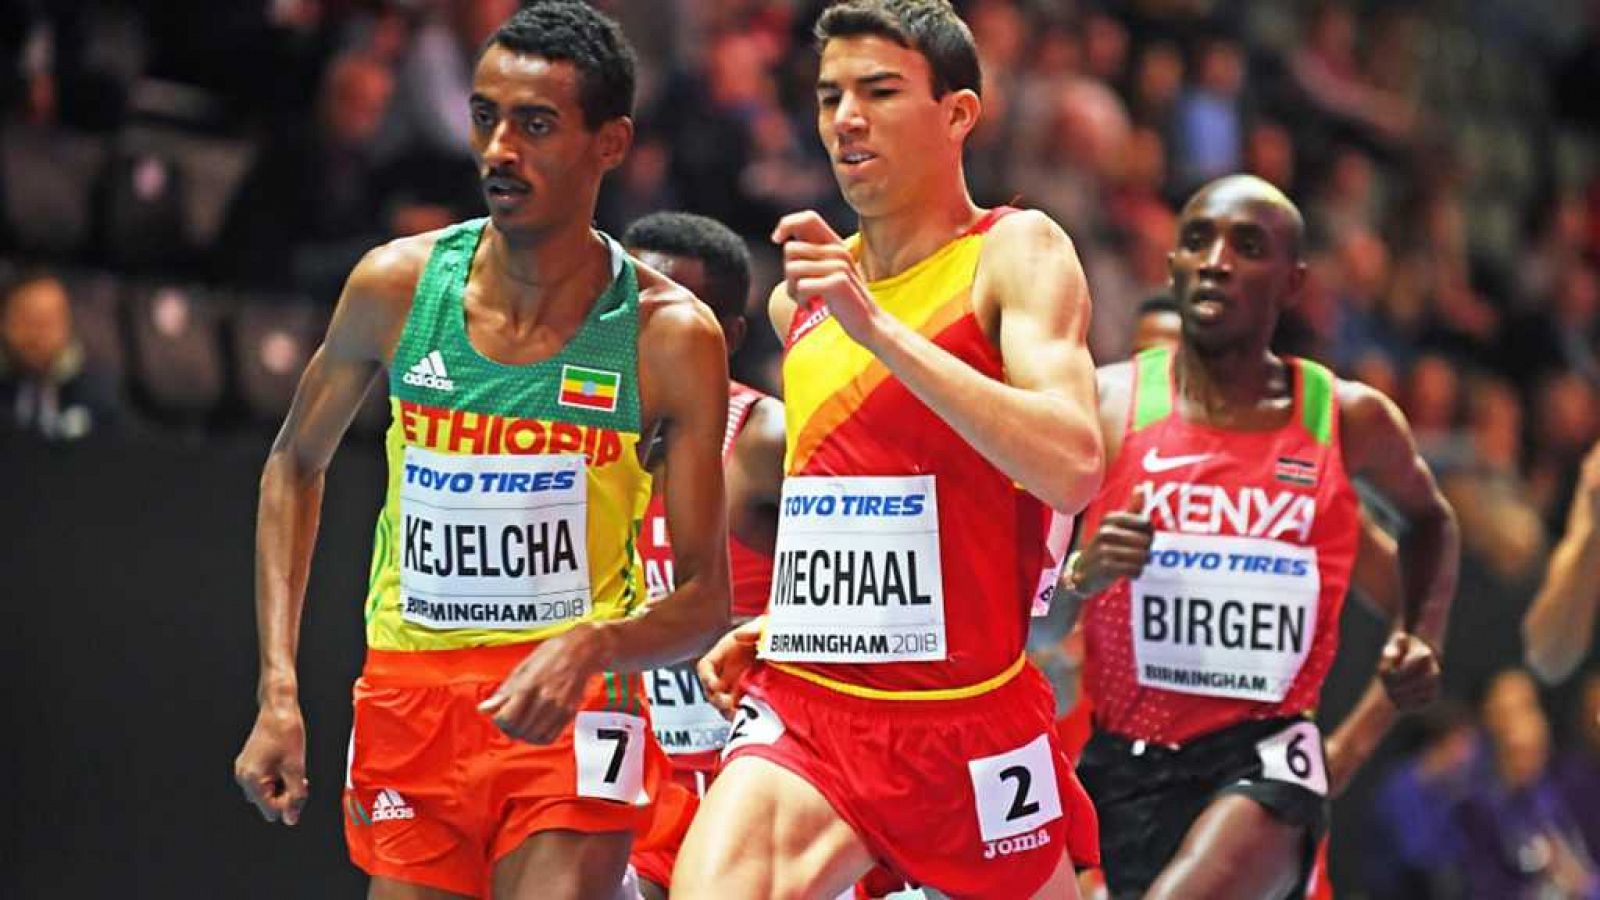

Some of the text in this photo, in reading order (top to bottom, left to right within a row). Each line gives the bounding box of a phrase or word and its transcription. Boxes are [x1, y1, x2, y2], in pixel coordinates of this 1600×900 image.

[402, 372, 454, 391] adidas
[479, 471, 576, 493] TIRES
[841, 494, 925, 516] TIRES
[1136, 481, 1316, 542] KENYA
[404, 515, 579, 578] KEJELCHA
[775, 549, 931, 606] MECHAAL
[1228, 554, 1308, 576] TIRES
[406, 596, 584, 622] BIRMINGHAM 2018
[1142, 596, 1306, 654] BIRGEN
[770, 633, 938, 654] BIRMINGHAM 2018
[1145, 664, 1268, 691] BIRMINGHAM
[597, 728, 630, 784] 7
[1286, 733, 1311, 780] 6
[1000, 764, 1040, 822] 2
[371, 805, 415, 823] adidas
